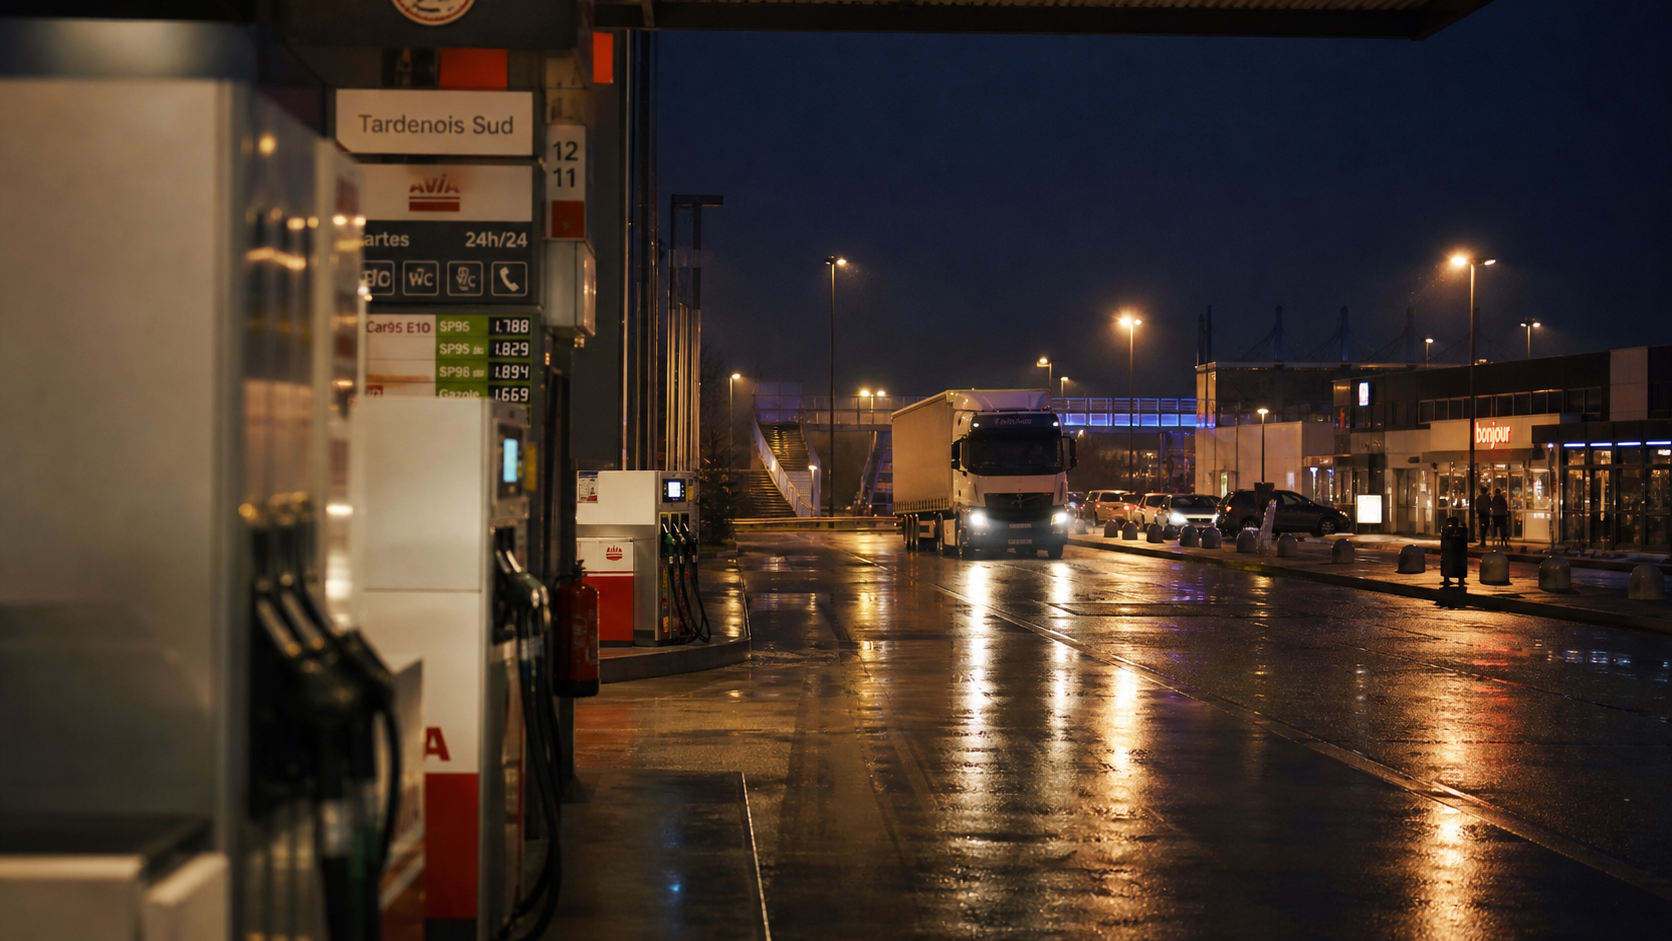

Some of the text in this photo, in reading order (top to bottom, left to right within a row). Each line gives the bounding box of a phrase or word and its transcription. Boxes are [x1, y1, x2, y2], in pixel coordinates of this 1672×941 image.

[358, 114, 514, 134] Tardenois Sud
[552, 141, 579, 161] 12
[553, 168, 575, 188] 11
[361, 232, 410, 247] artes
[465, 231, 528, 248] 24h/24
[407, 322, 431, 334] E10
[439, 319, 530, 333] SP95 1.788
[439, 343, 470, 355] SP95
[495, 341, 530, 356] 1.829
[495, 364, 530, 379] 1.894
[495, 386, 530, 402] 1.669
[1476, 421, 1511, 449] bonjour
